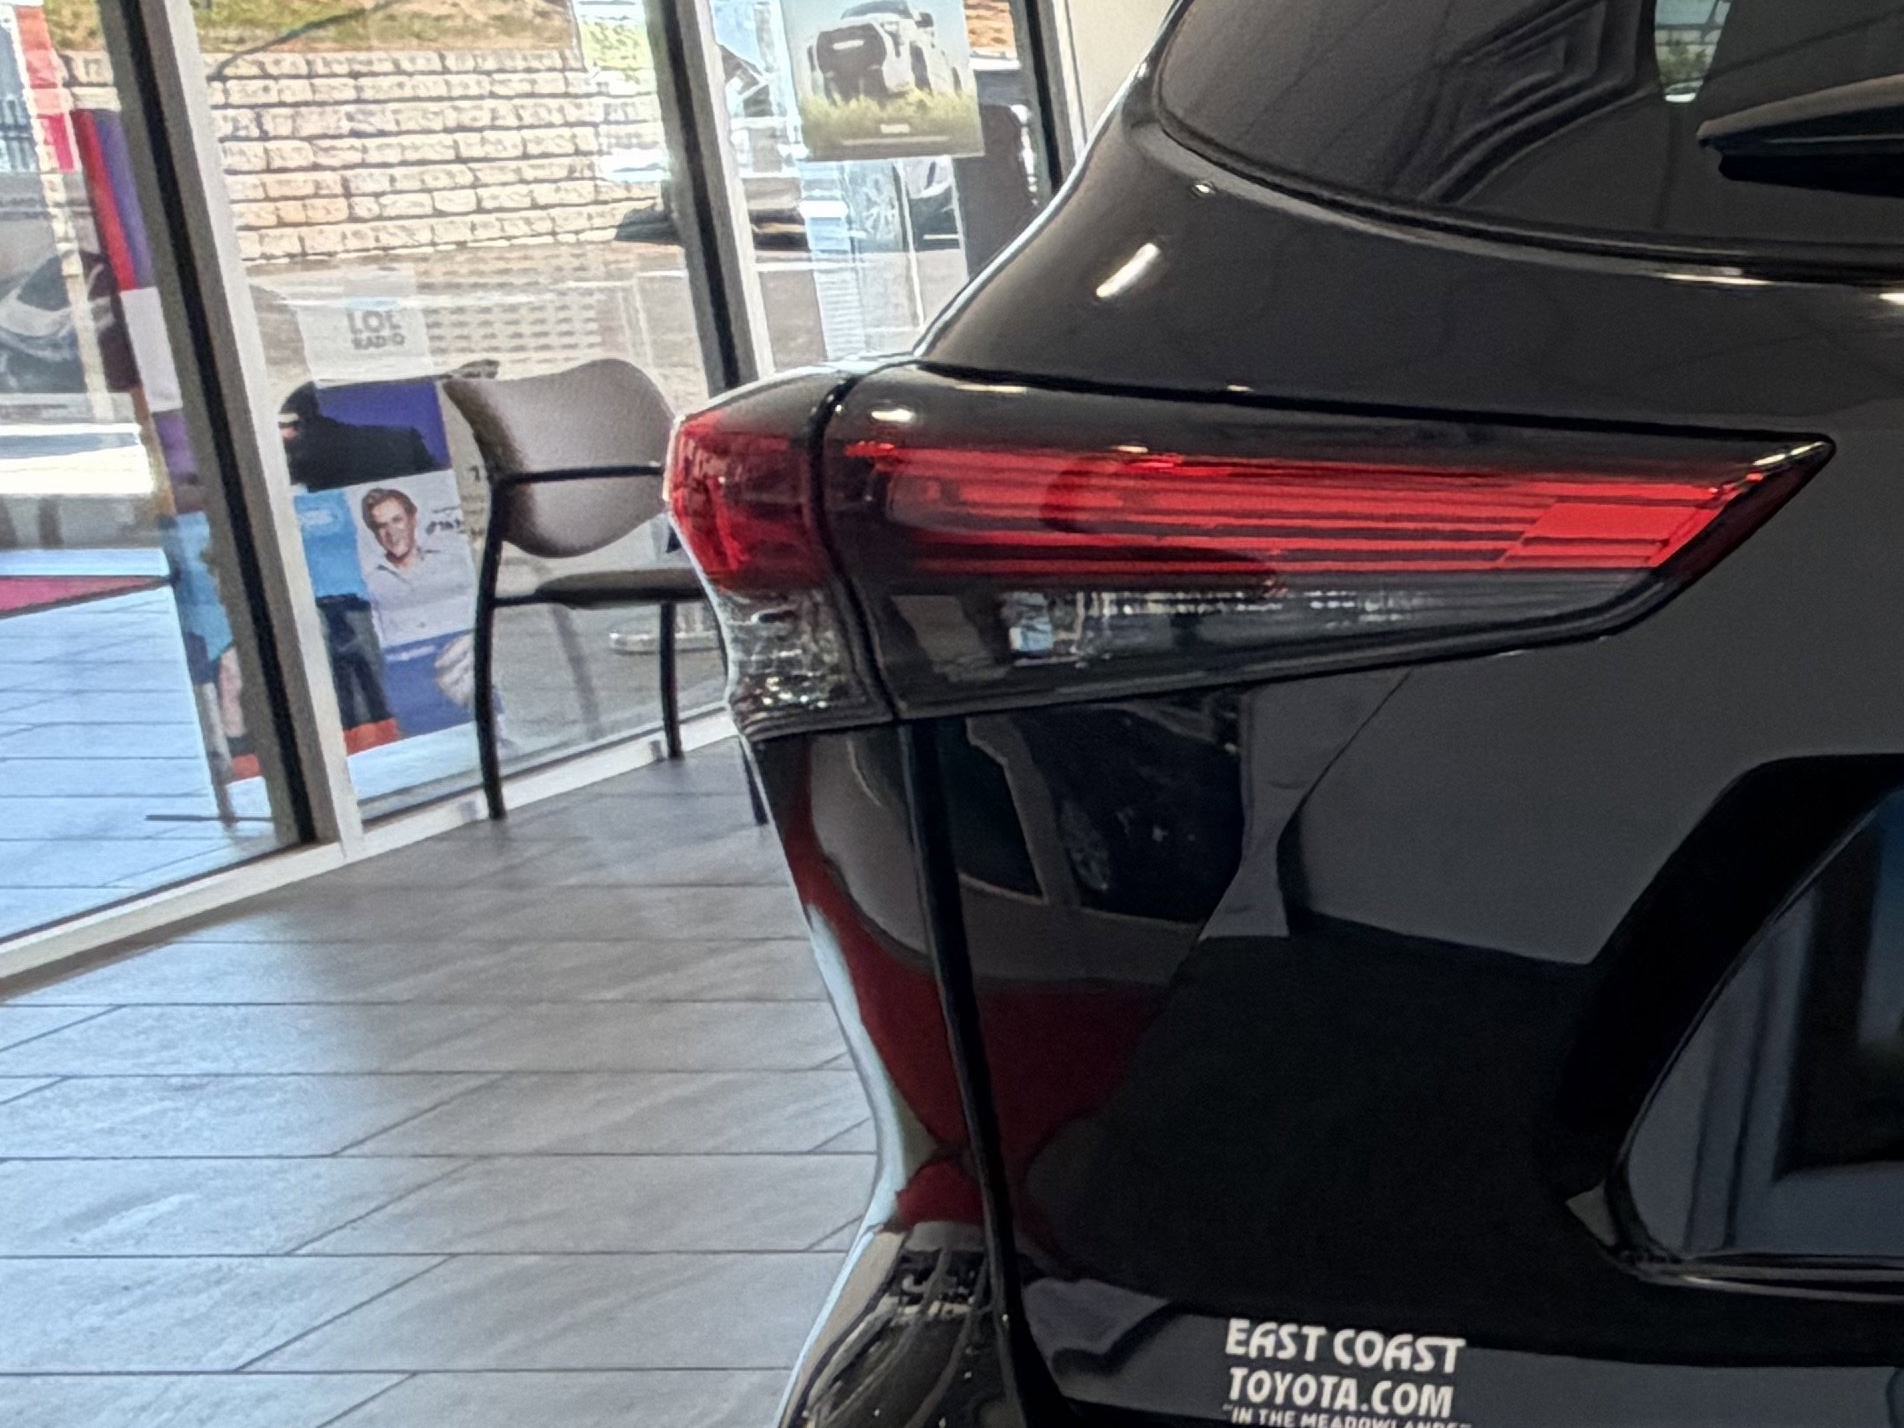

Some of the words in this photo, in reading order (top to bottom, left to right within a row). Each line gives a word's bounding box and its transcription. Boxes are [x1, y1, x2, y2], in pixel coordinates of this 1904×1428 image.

[1225, 1317, 1328, 1362] EAST
[1332, 1328, 1467, 1374] COAST
[1229, 1366, 1455, 1419] TOYOTA.COM
[1258, 1407, 1297, 1428] THE
